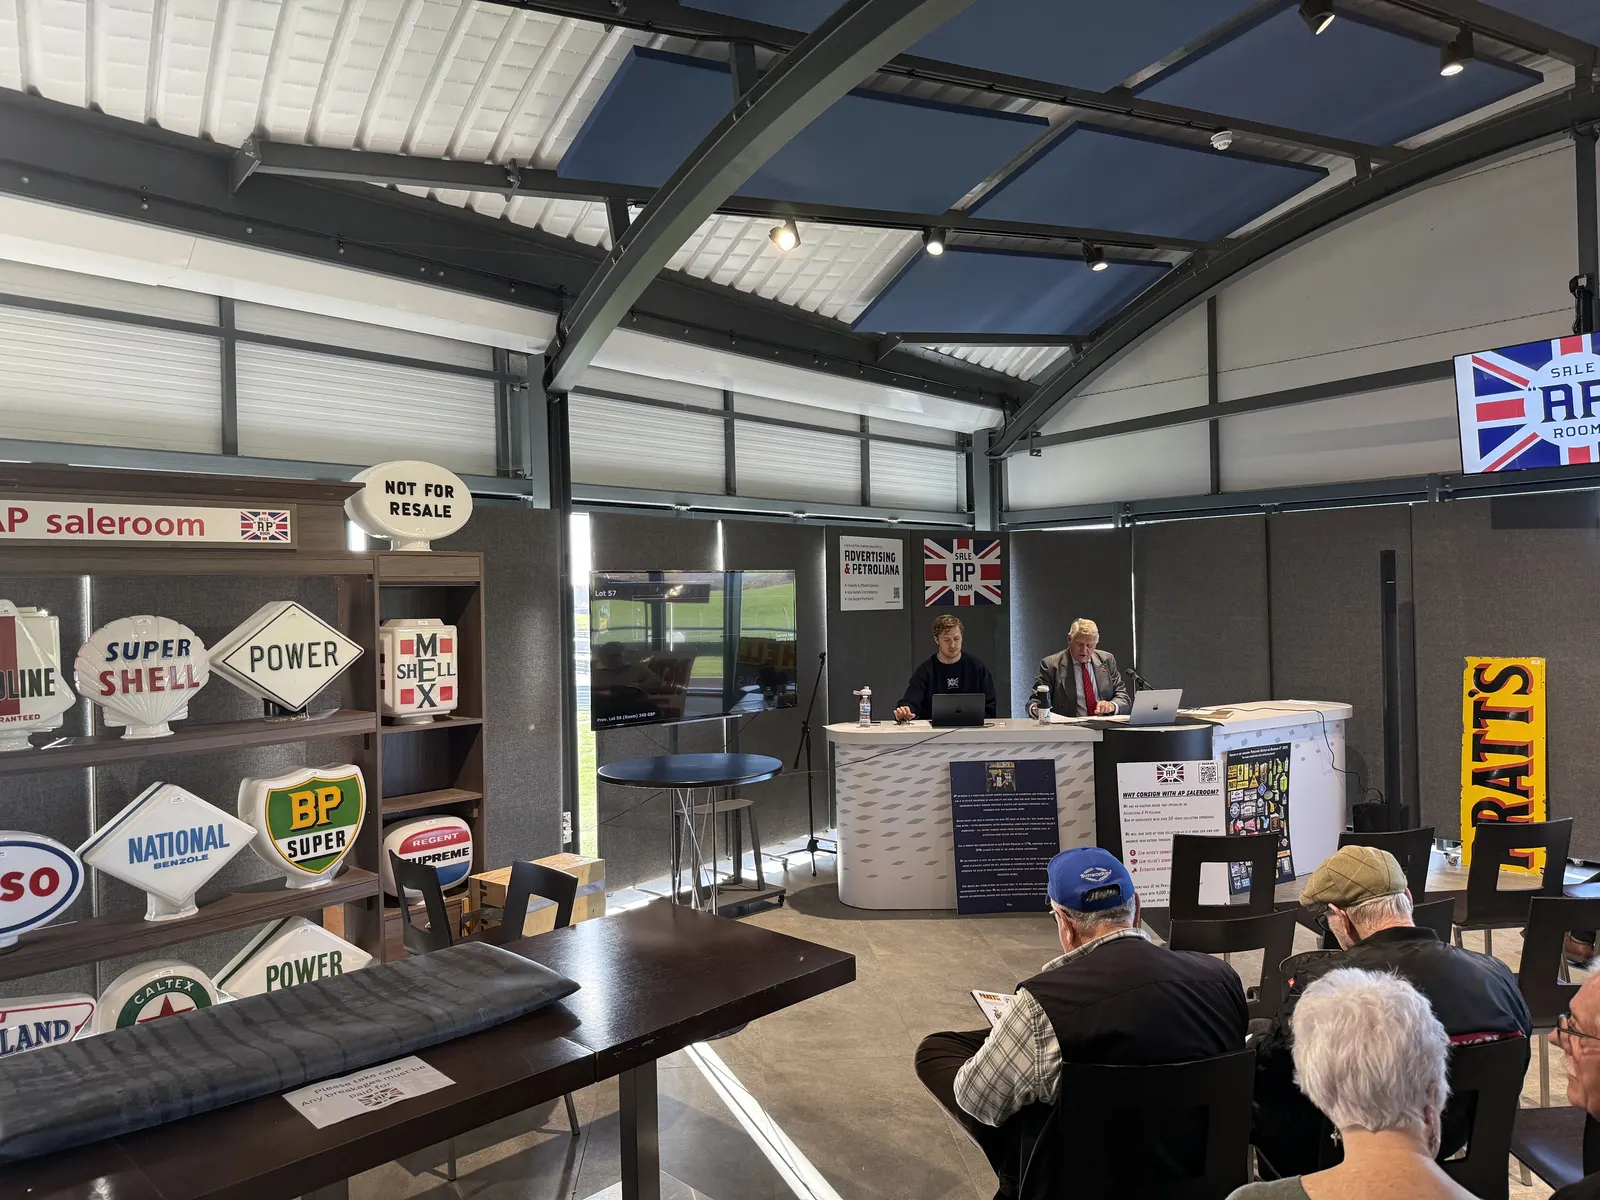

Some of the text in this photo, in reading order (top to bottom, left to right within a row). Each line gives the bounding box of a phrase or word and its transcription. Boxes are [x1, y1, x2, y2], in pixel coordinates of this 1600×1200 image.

[1551, 362, 1595, 378] SALE
[385, 480, 455, 499] NOT FOR
[0, 507, 205, 537] P saleroom
[389, 501, 452, 518] RESALE
[844, 549, 896, 563] ADVERTISING
[955, 552, 972, 561] SALE
[844, 563, 900, 576] & PETROLIANA
[952, 562, 976, 583] AP
[955, 584, 973, 592] ROOM
[105, 638, 192, 662] SUPER
[250, 639, 340, 673] POWER
[99, 664, 200, 697] SHELL
[397, 658, 457, 683] SHELL
[1467, 663, 1534, 870] RATT'S
[287, 785, 344, 831] BP
[128, 822, 230, 865] NATIONAL
[287, 829, 346, 859] SUPER
[412, 832, 459, 847] REGENT
[153, 853, 209, 870] BENZOLE
[266, 949, 344, 994] POWER
[133, 977, 195, 1006] CALTEX
[0, 1019, 72, 1057] LAND
[301, 1064, 427, 1108] Any breakages must be
[314, 1065, 402, 1095] Please take care
[349, 1081, 392, 1099] paid for
